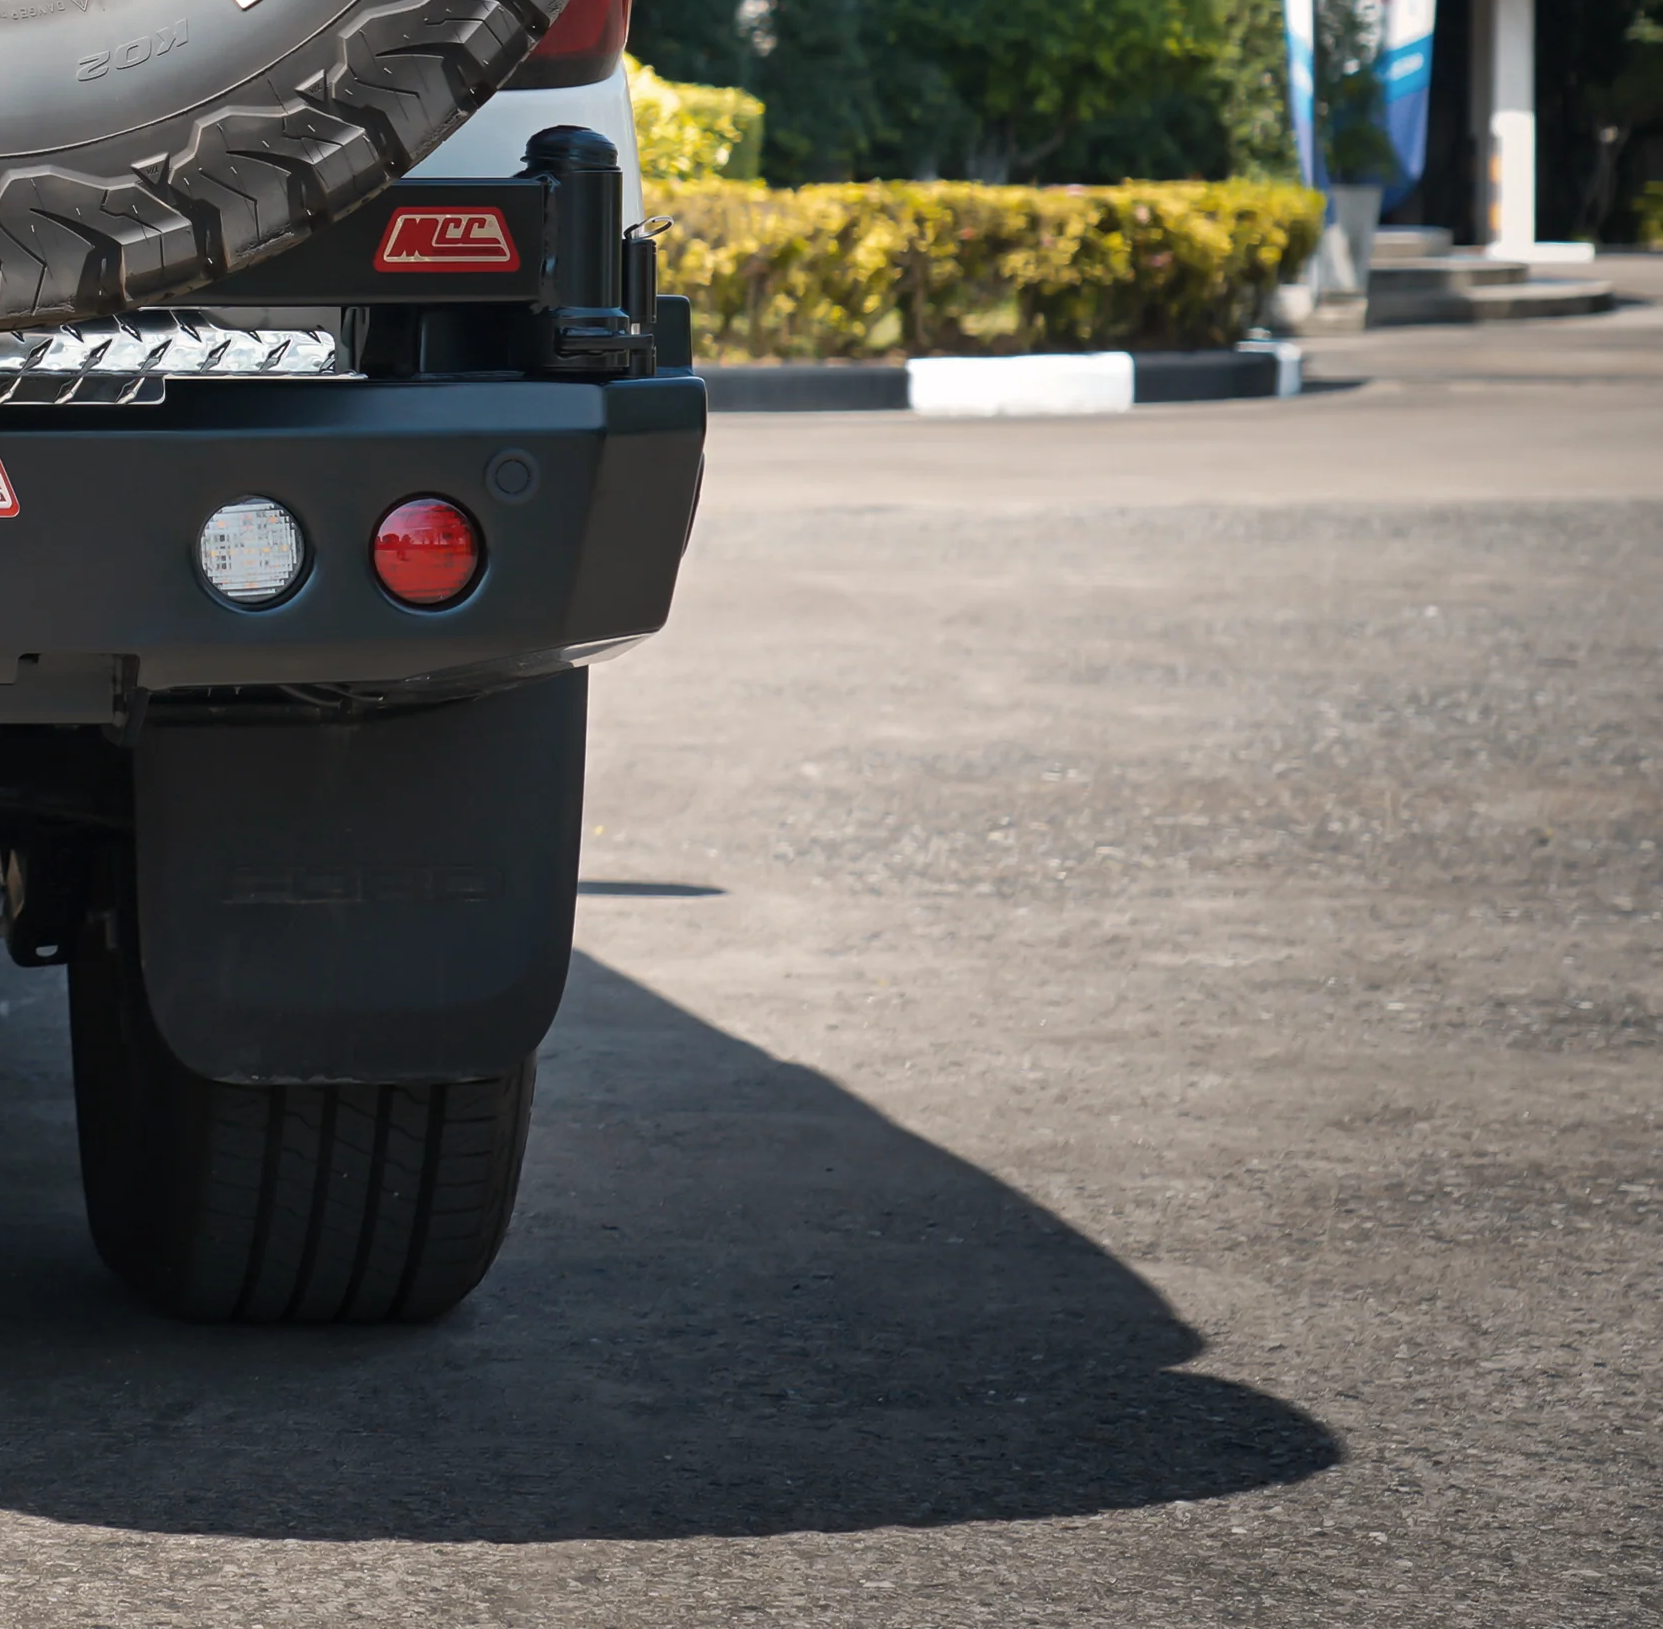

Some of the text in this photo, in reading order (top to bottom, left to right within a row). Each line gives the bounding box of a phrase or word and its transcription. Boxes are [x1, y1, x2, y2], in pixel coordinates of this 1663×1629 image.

[12, 2, 67, 21] DANGER
[76, 18, 189, 82] KO2
[387, 218, 501, 257] MCC
